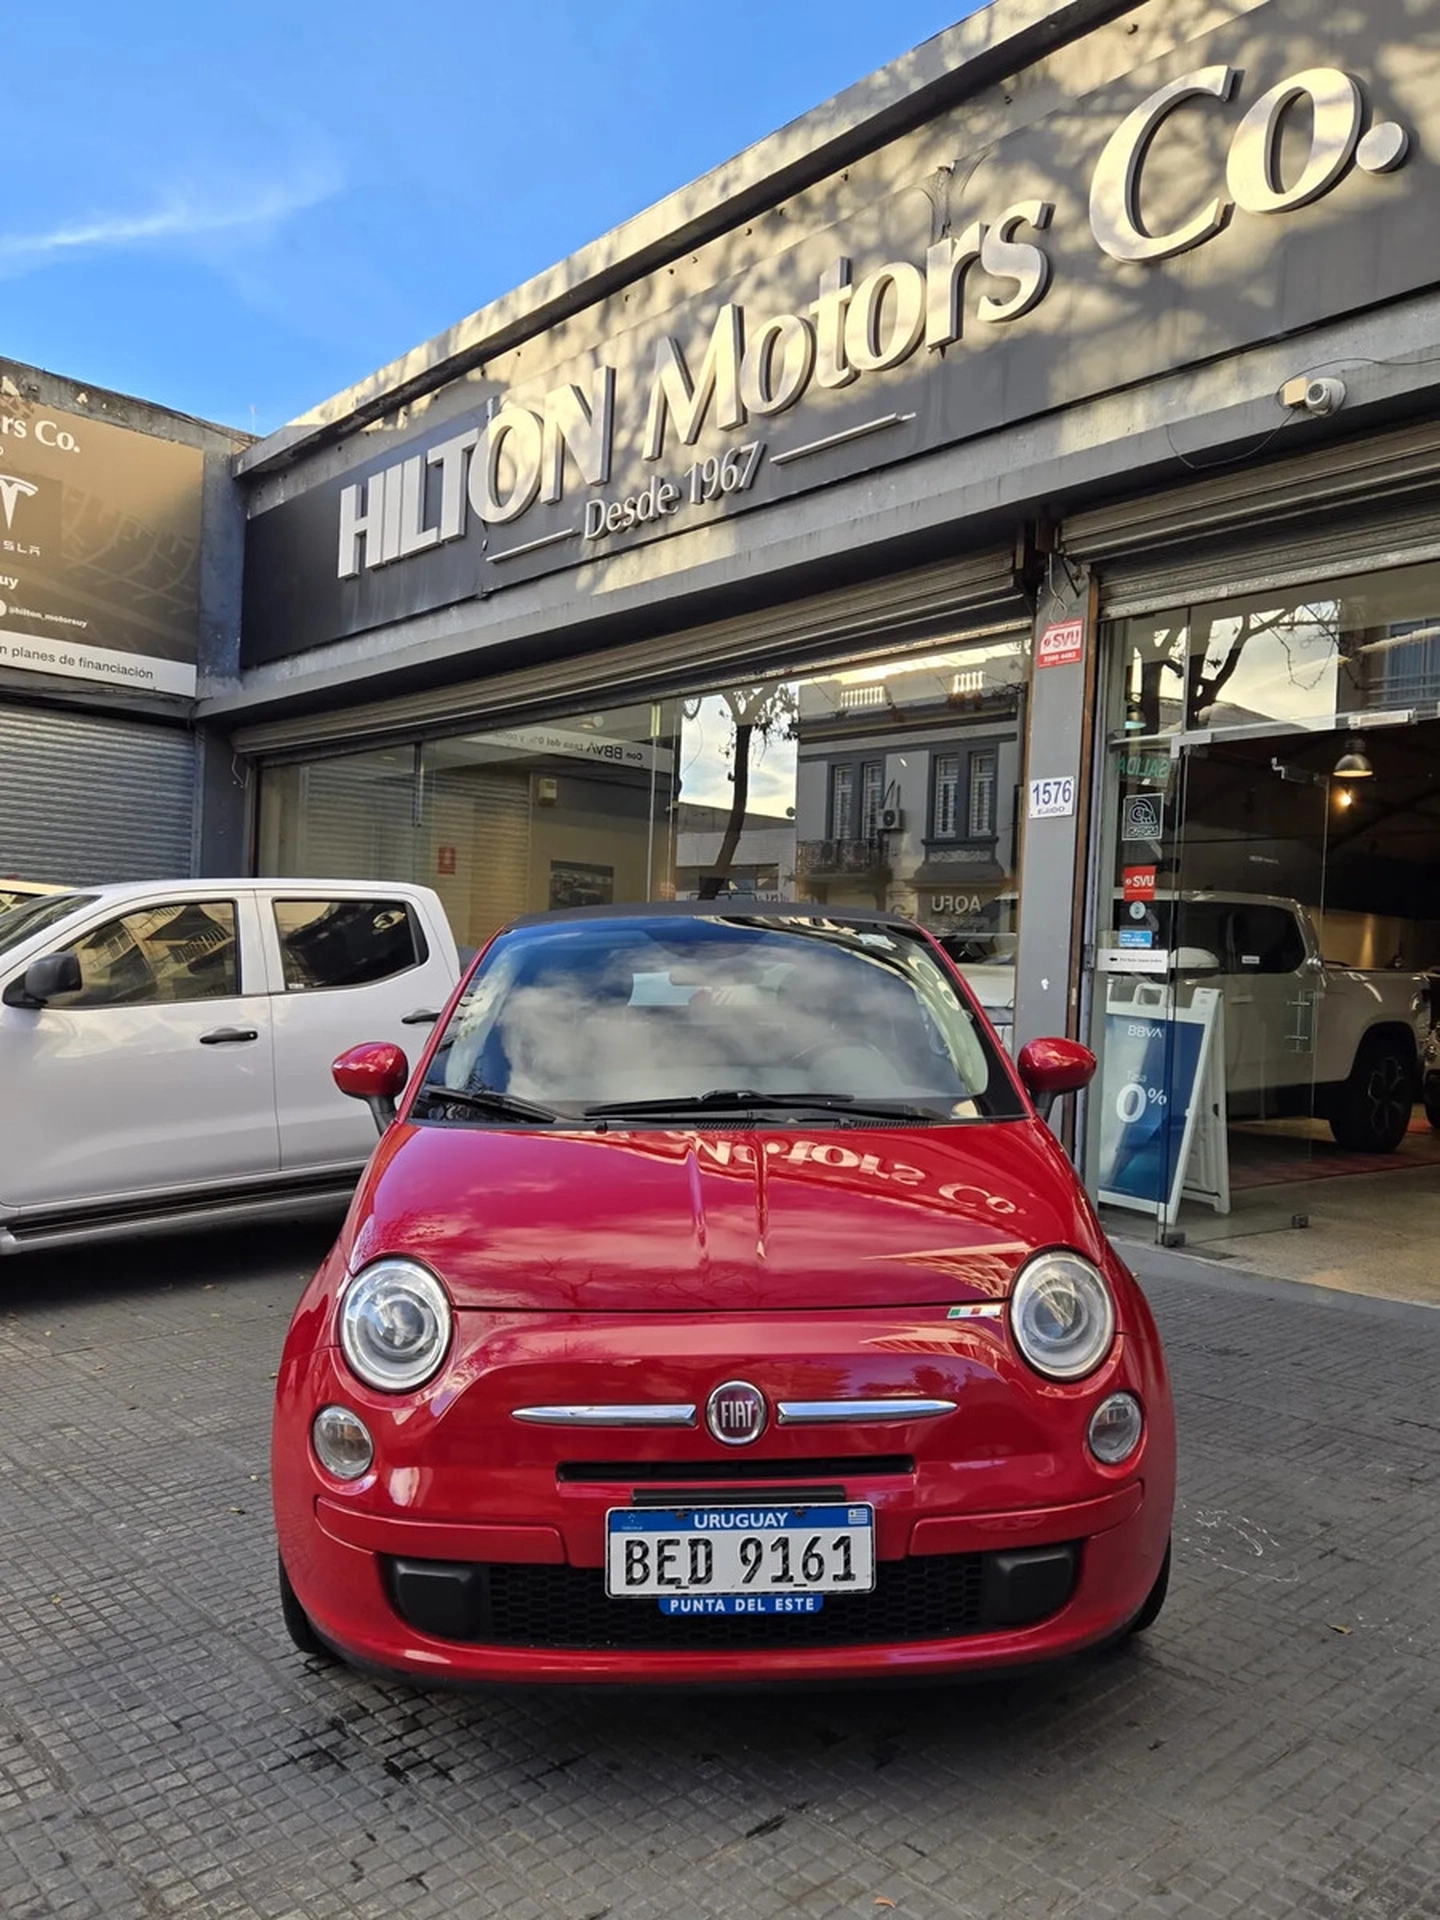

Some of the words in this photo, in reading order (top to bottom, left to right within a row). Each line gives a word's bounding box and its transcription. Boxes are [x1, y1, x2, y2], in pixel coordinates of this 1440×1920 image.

[338, 365, 615, 578] HILTON
[642, 200, 1055, 461] Motors
[1089, 65, 1408, 263] Co.
[35, 420, 80, 453] Co.
[583, 475, 679, 541] Desde
[685, 440, 766, 504] 1967
[1053, 630, 1079, 648] SVU
[12, 647, 55, 662] planes
[59, 654, 75, 666] de
[79, 657, 154, 679] financiación
[1033, 780, 1071, 806] 1576
[1132, 875, 1155, 888] SVU
[1127, 1025, 1163, 1038] BBVA
[721, 1401, 755, 1428] FIAT
[694, 1512, 788, 1528] URUGUAY
[625, 1538, 713, 1586] BED
[739, 1535, 856, 1584] 9161
[670, 1599, 726, 1612] PUNTA
[735, 1598, 765, 1612] DEL
[775, 1598, 814, 1611] ESTE
